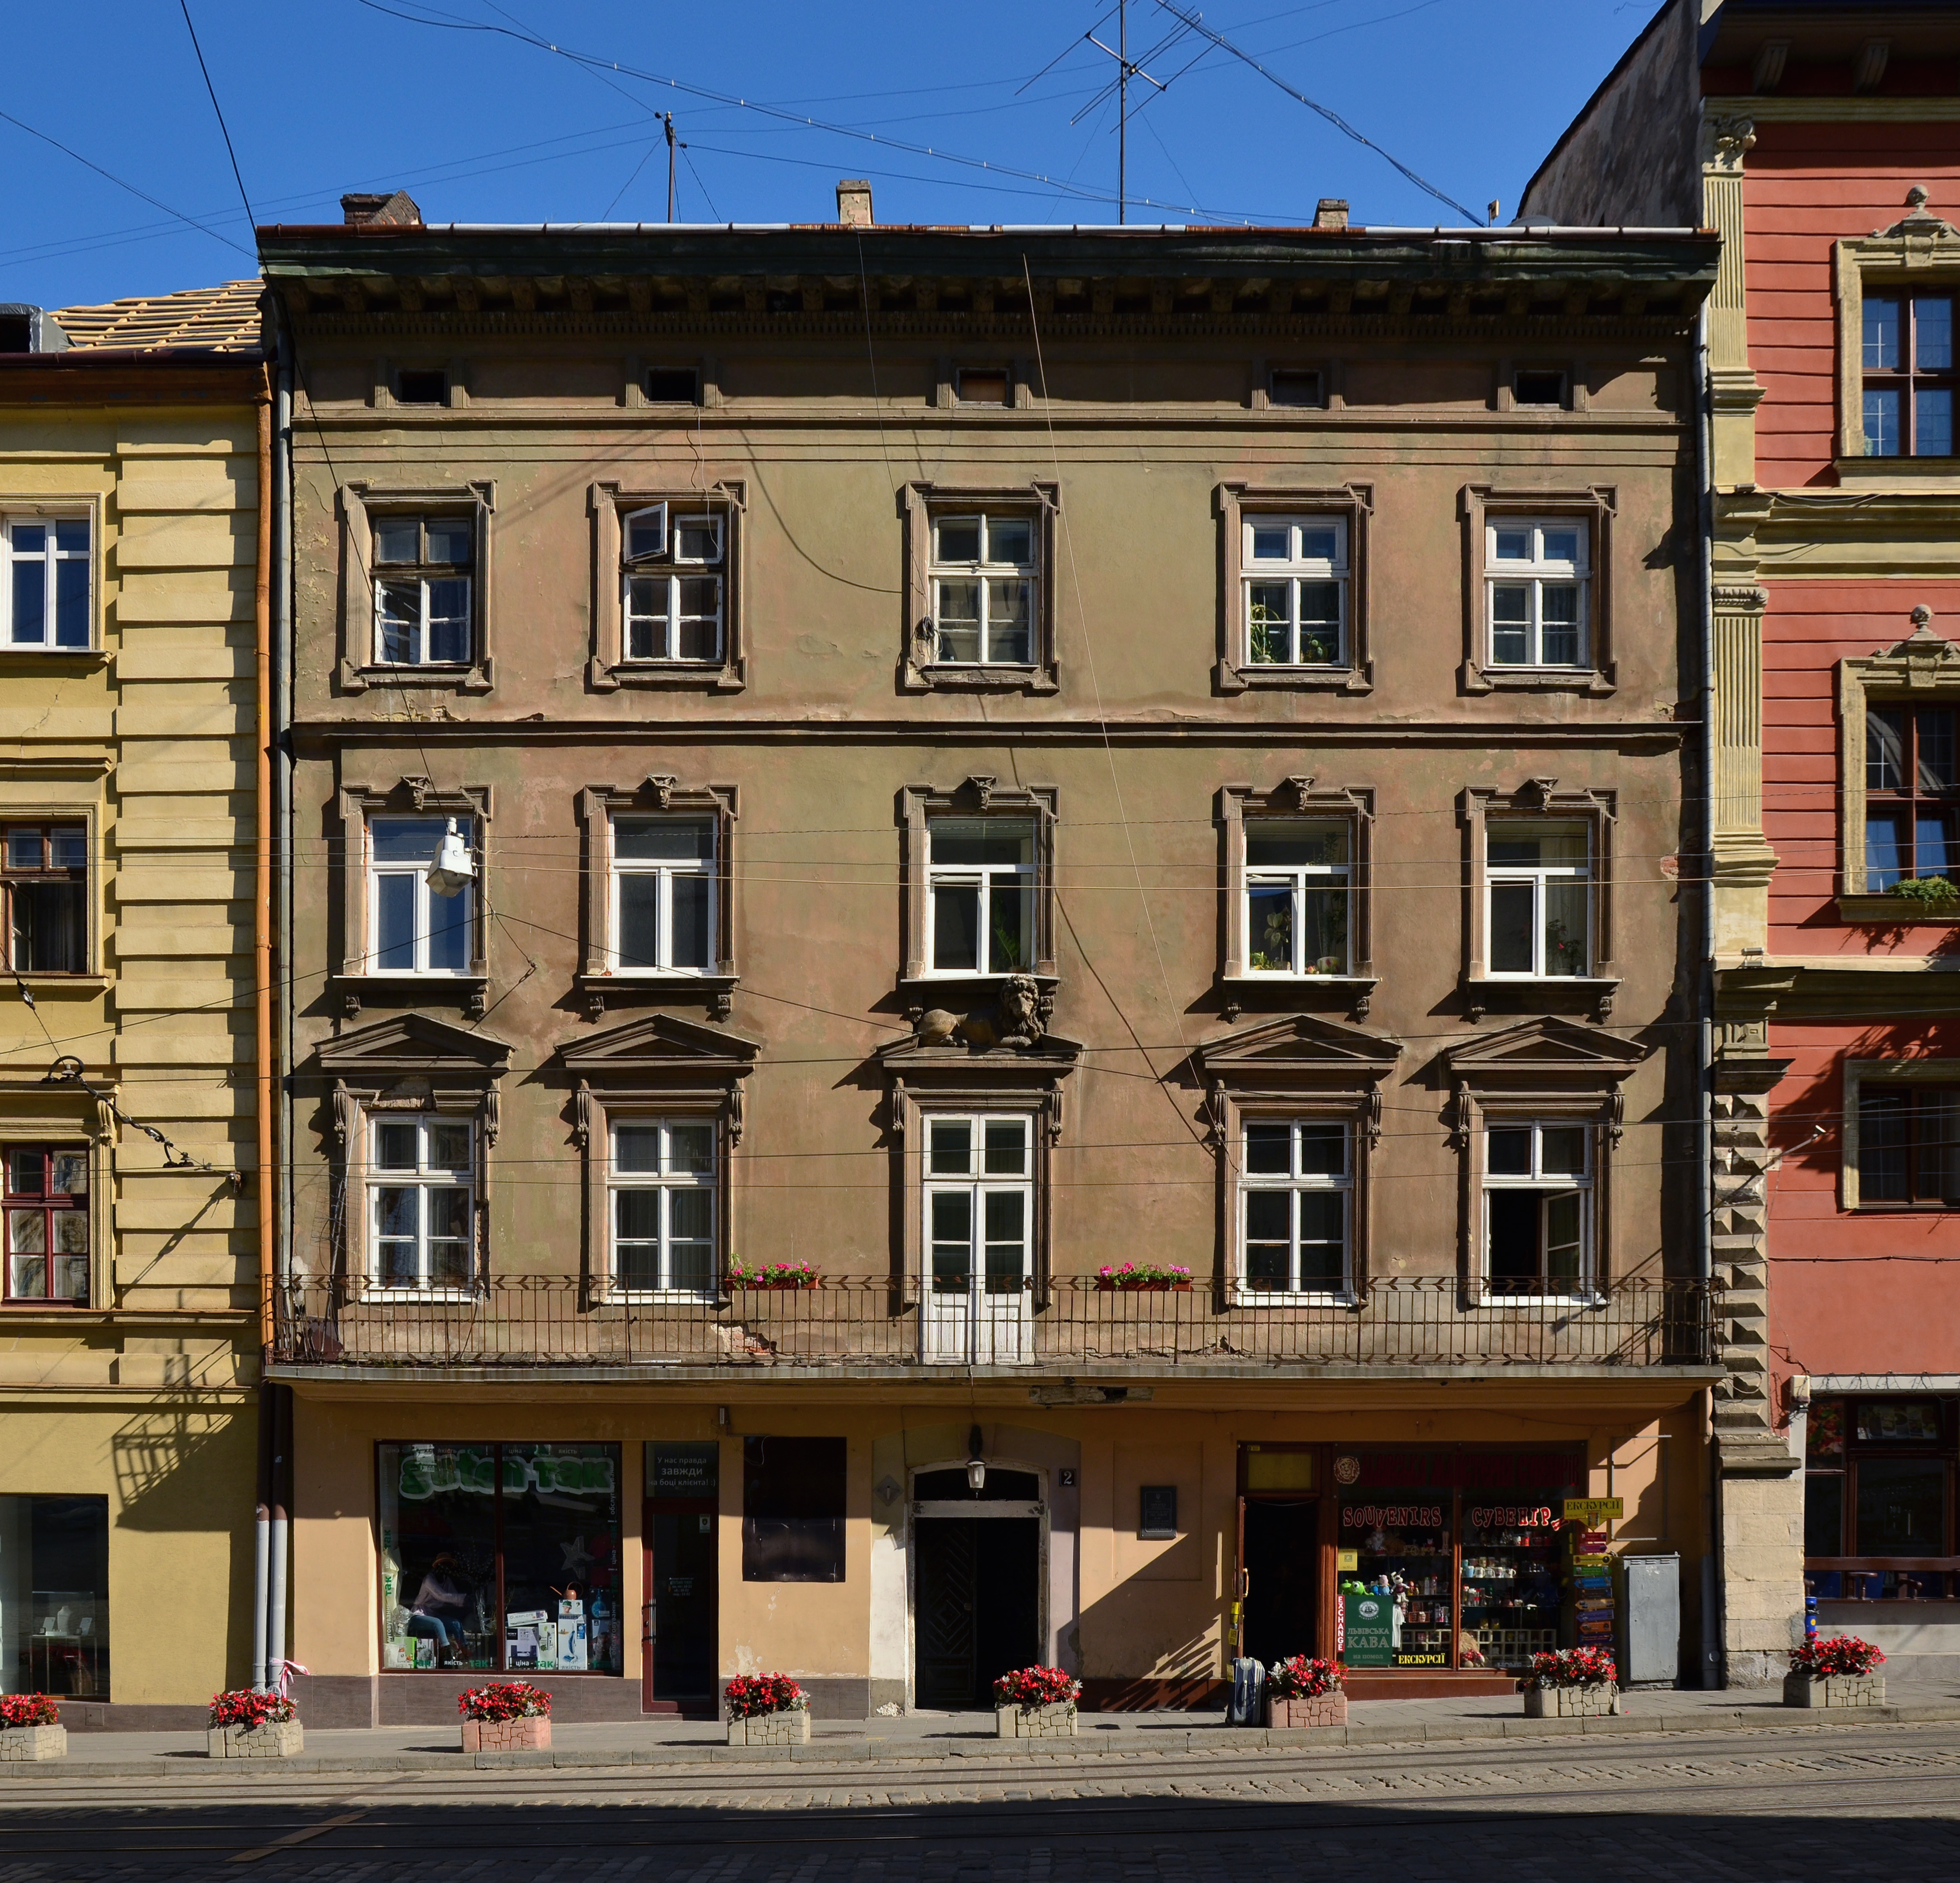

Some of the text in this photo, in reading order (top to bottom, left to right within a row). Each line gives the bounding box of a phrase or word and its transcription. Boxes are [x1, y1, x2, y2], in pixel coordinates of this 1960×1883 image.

[400, 1452, 612, 1496] guten так
[661, 1468, 703, 1477] завжди
[1064, 1471, 1072, 1485] 2
[660, 1479, 676, 1487] боці
[1567, 1499, 1620, 1510] ЕКСКУРСІЇ
[1343, 1506, 1442, 1527] SOUVENIRS
[1347, 1636, 1389, 1648] КАВА
[515, 1659, 529, 1668] ціна
[1398, 1653, 1445, 1664] ЕКСКУРСІЇ
